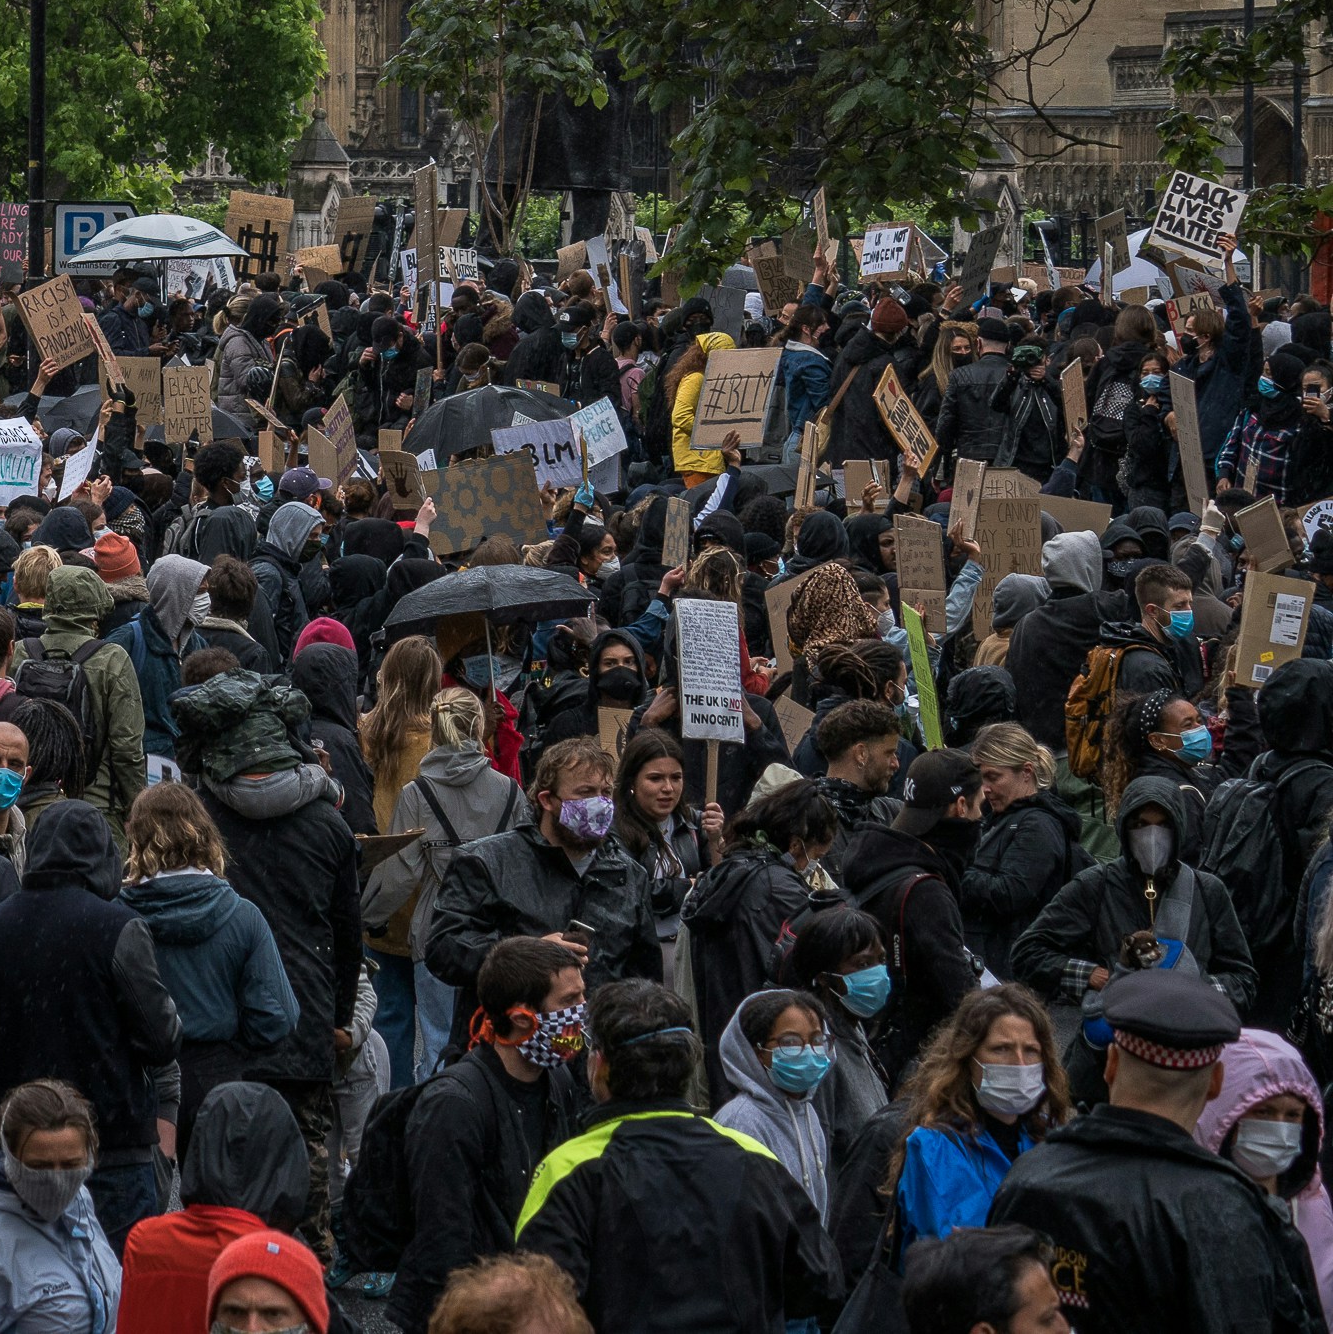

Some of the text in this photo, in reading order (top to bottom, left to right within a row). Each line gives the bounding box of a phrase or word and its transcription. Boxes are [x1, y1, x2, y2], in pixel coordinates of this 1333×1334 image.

[1171, 173, 1238, 213] BLACK
[1163, 193, 1224, 229] LIVES
[3, 249, 22, 262] OUR
[59, 260, 112, 269] Westminster
[21, 278, 75, 318] RACISM
[169, 377, 207, 396] BLACK
[704, 370, 775, 418] #BLM
[175, 396, 206, 414] LIVES
[168, 416, 212, 436] MATTER
[998, 503, 1038, 523] CANNOT
[1006, 527, 1036, 548] SILENT
[684, 694, 728, 706] THE UK IS
[691, 713, 739, 728] INNOCENT!
[893, 934, 901, 967] Canon
